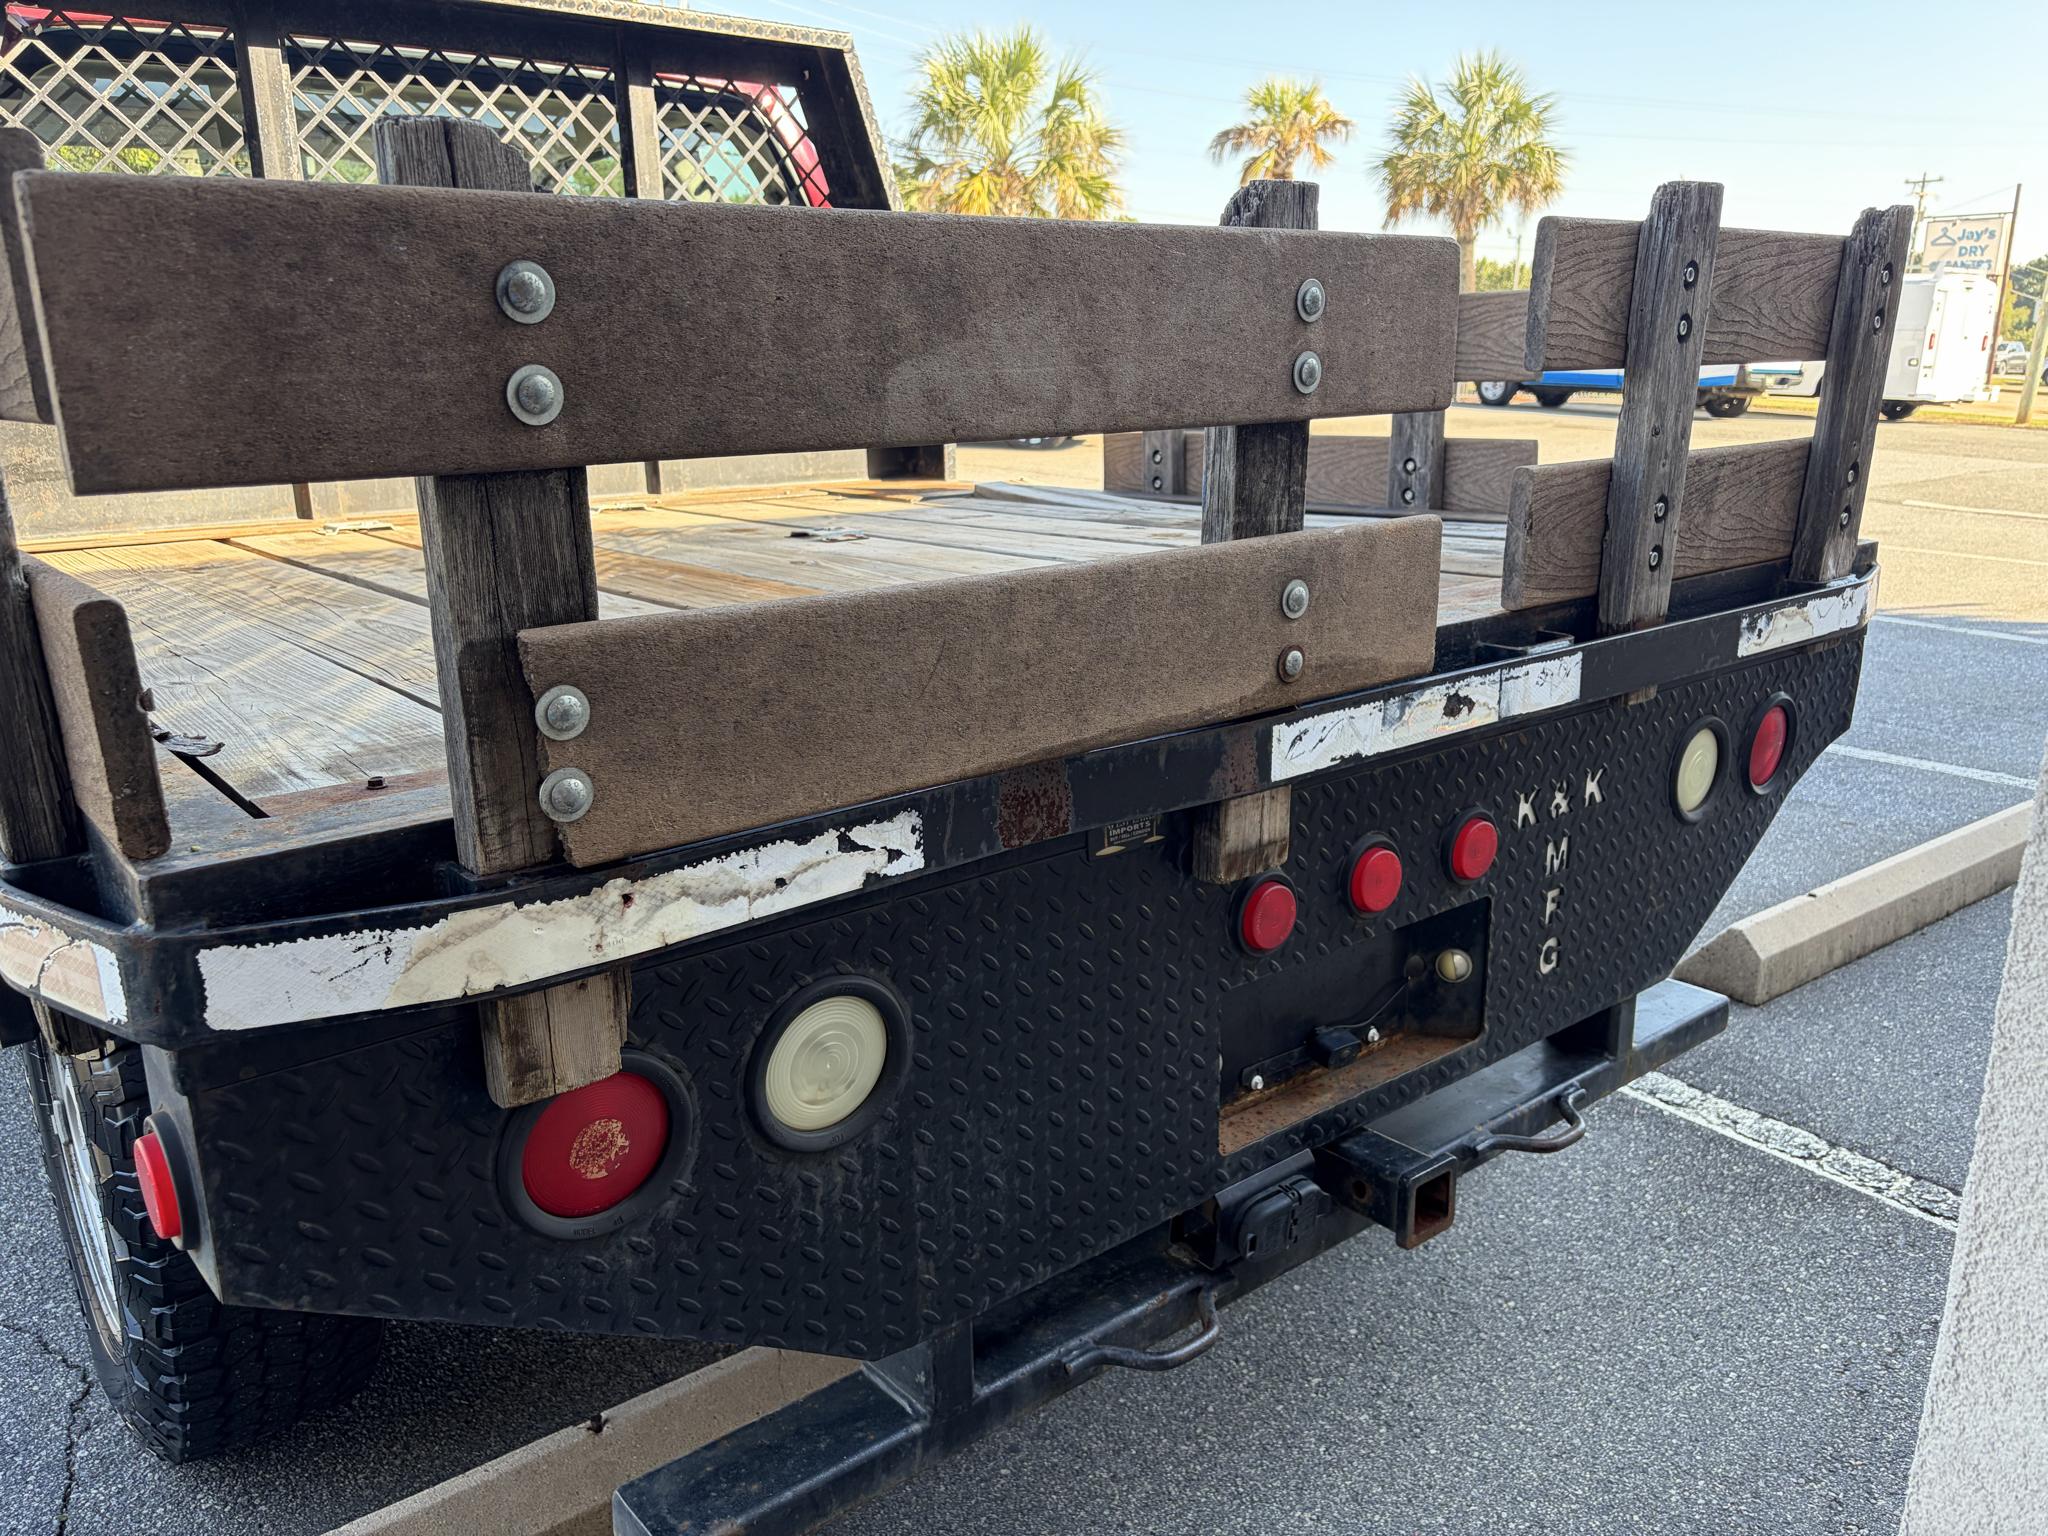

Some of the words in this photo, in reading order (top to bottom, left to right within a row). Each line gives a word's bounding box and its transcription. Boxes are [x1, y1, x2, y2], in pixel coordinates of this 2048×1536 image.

[1958, 227, 1996, 241] Jay's
[1958, 245, 1988, 257] DRY
[1517, 785, 1540, 830] K
[1551, 779, 1572, 819] &
[1585, 766, 1608, 808] K
[1109, 820, 1151, 837] IMPORTS
